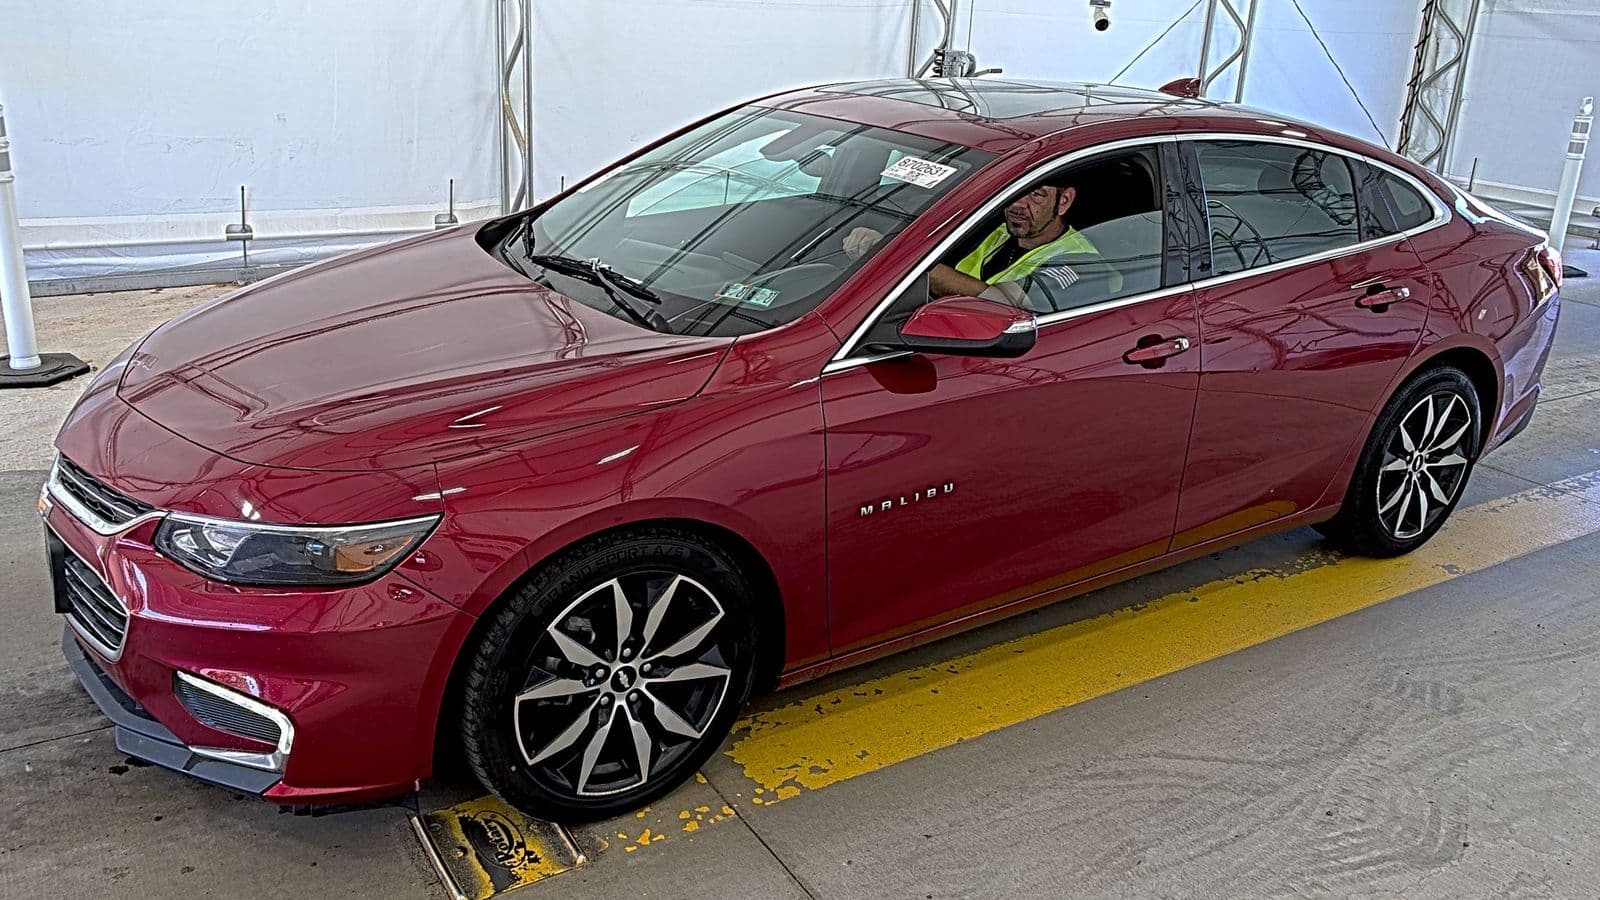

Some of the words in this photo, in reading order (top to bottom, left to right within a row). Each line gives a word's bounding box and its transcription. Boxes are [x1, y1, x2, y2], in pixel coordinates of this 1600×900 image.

[898, 158, 948, 177] 8702631
[860, 483, 954, 517] MALIBU
[596, 547, 649, 567] SPORT
